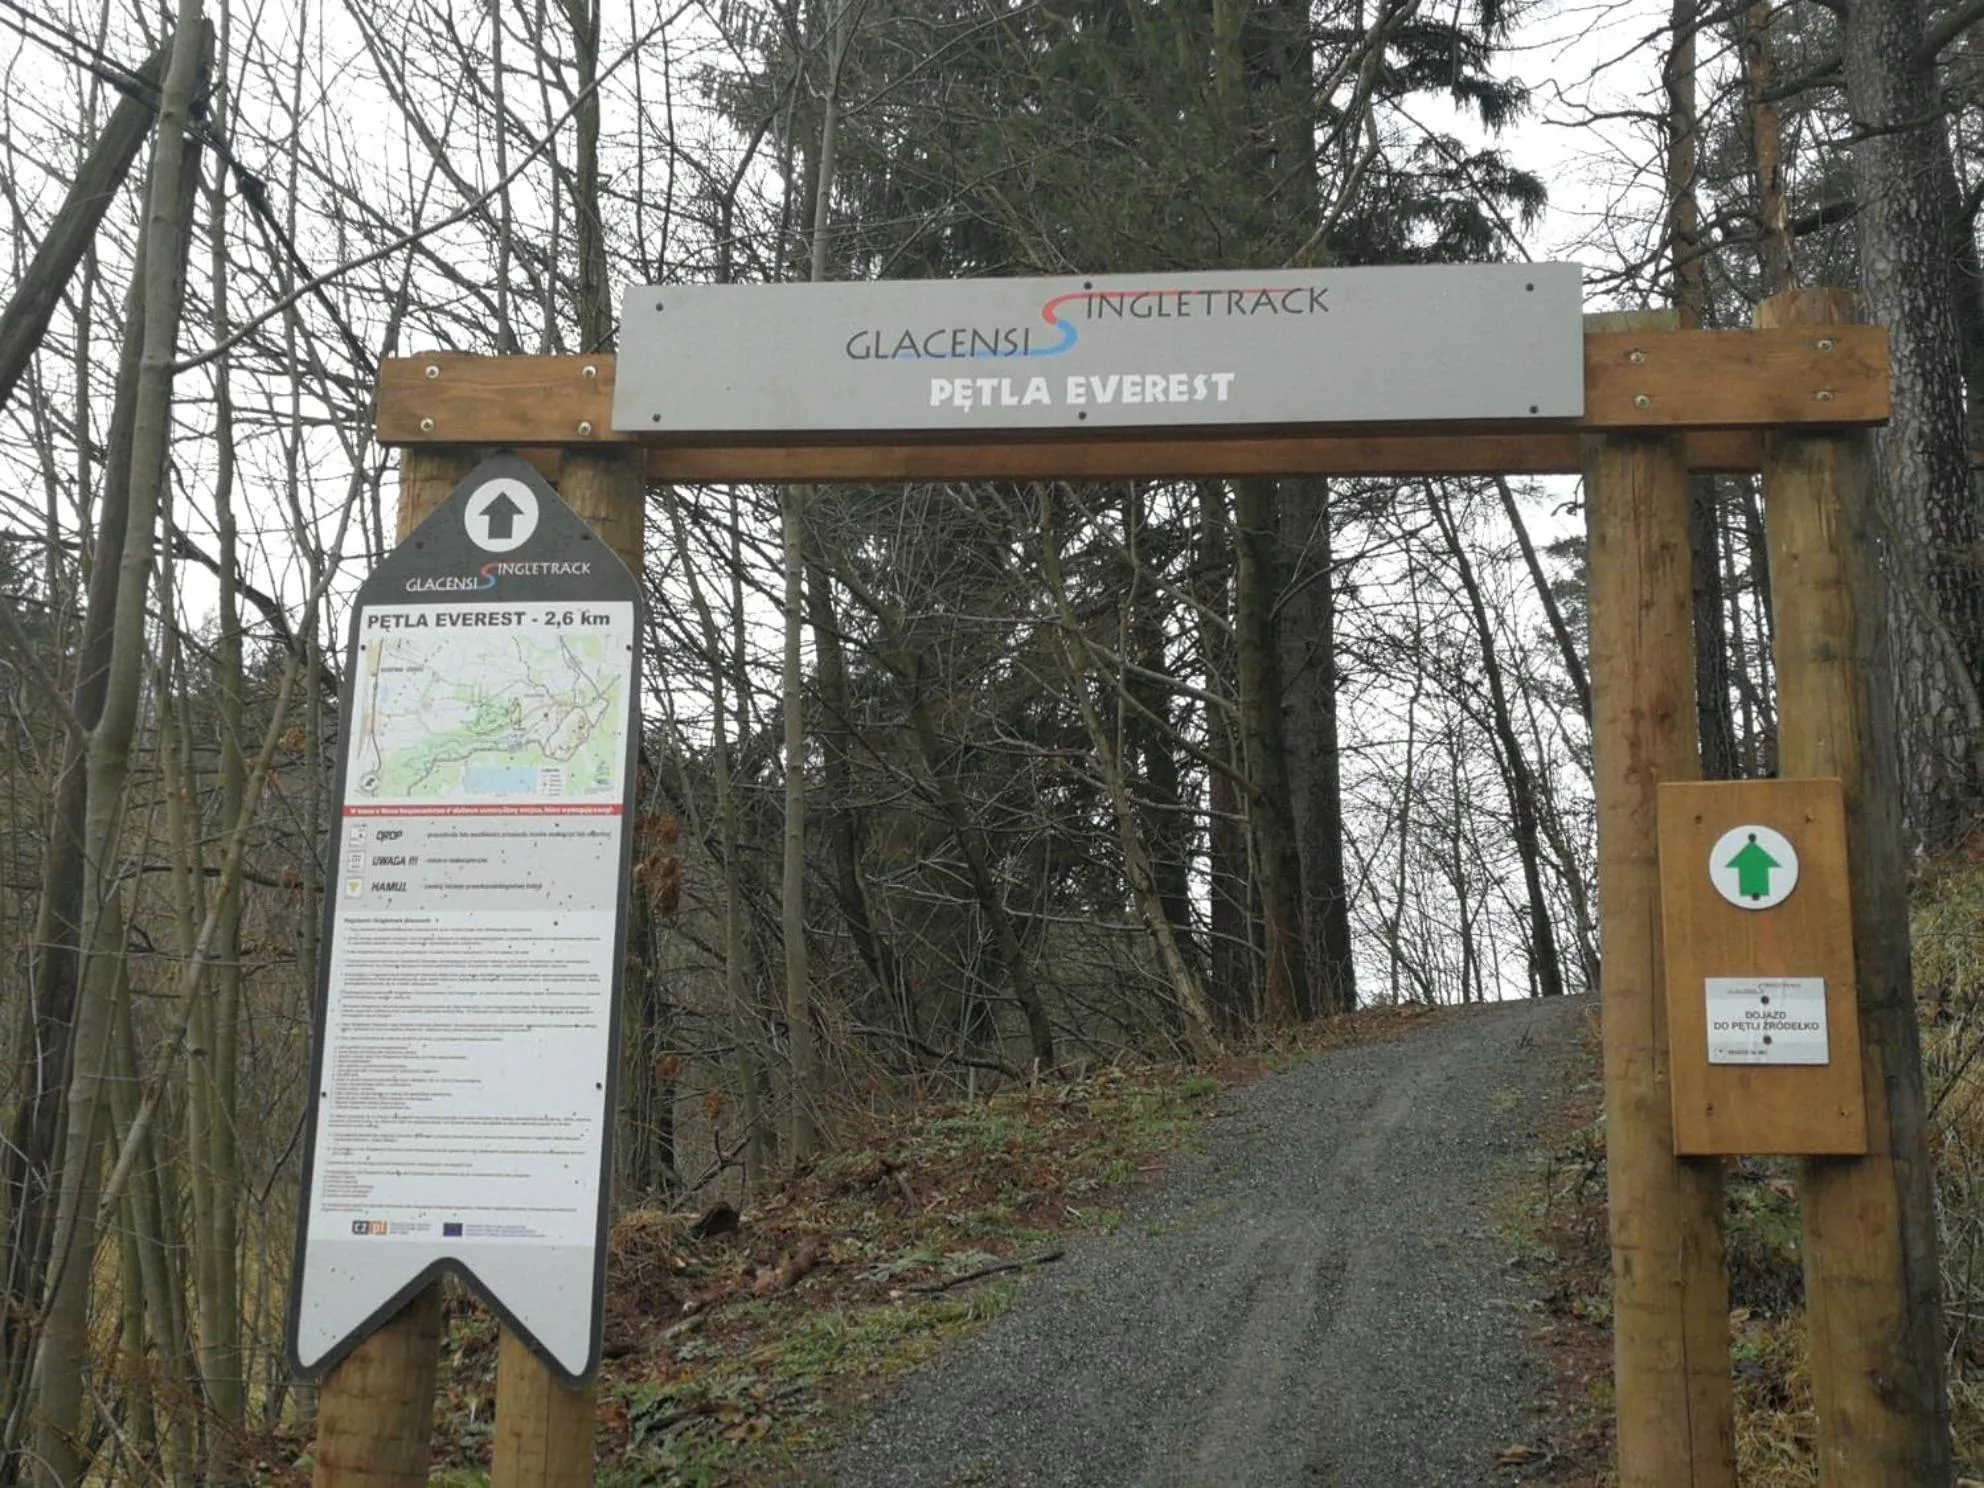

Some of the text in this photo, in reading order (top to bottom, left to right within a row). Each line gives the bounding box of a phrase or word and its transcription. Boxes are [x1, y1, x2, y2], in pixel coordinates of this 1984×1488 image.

[930, 372, 1236, 412] PĘTLA EVEREST
[367, 613, 429, 632] PĘTLA
[435, 611, 526, 627] EVEREST
[544, 610, 574, 628] 2,6
[580, 611, 611, 626] km
[372, 855, 406, 867] UWAGA
[1745, 1010, 1787, 1020] DOJAZD
[1713, 1021, 1730, 1031] DO
[1731, 1021, 1760, 1033] PĘTLI
